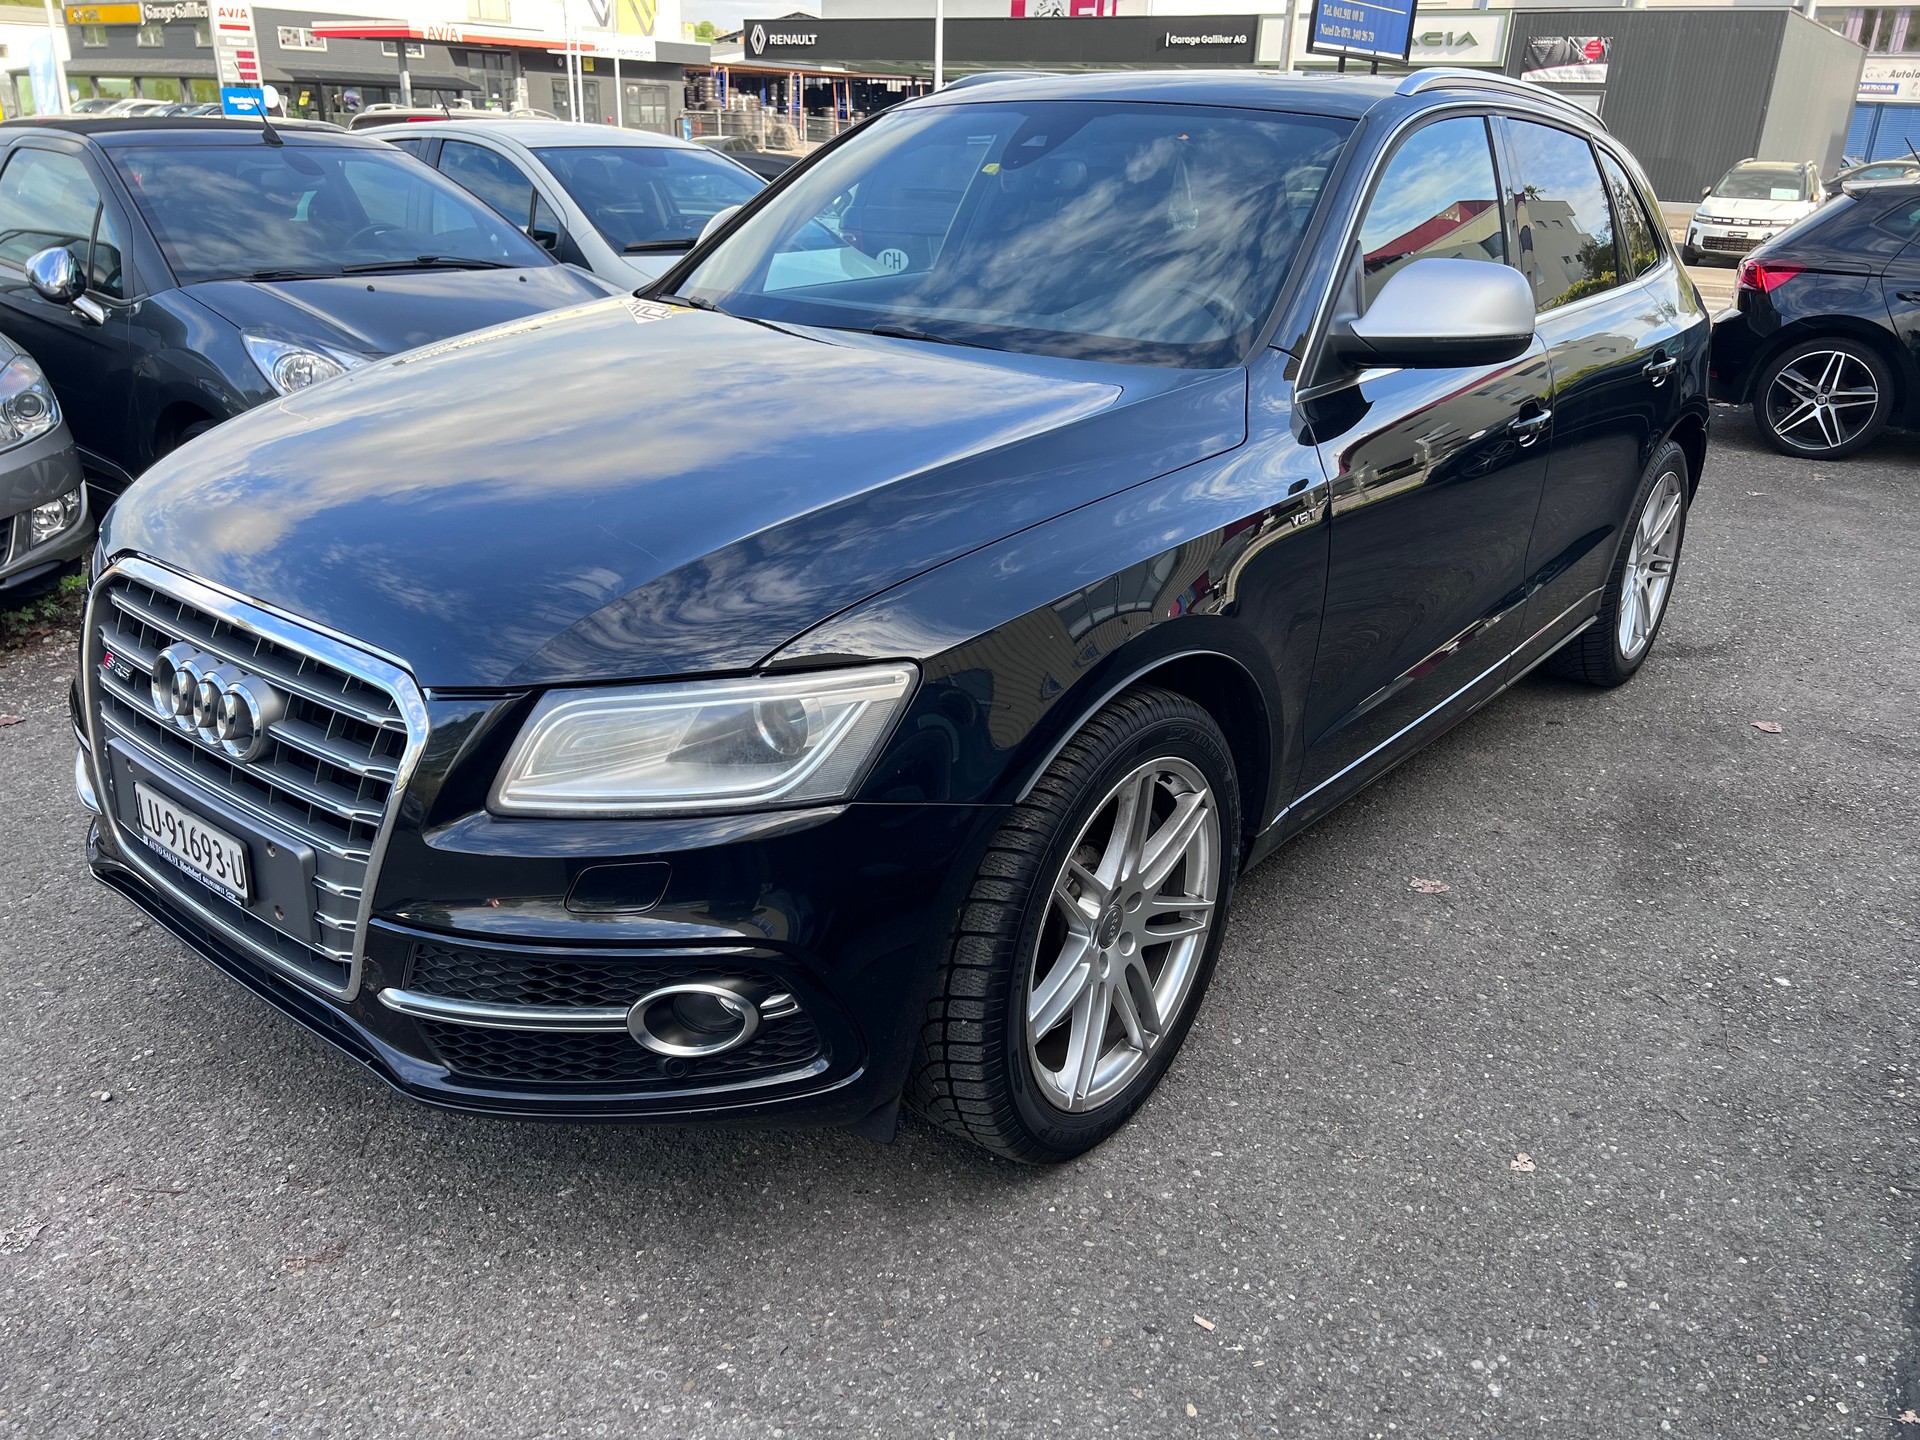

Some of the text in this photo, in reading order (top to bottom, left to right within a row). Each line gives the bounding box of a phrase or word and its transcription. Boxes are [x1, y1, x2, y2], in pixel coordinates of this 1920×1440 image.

[145, 4, 175, 23] Garage
[218, 7, 249, 19] AVIA
[428, 26, 459, 42] AVIA
[769, 34, 818, 45] RENAULT
[1170, 34, 1247, 46] Garage Galliker AG
[883, 252, 901, 270] CH
